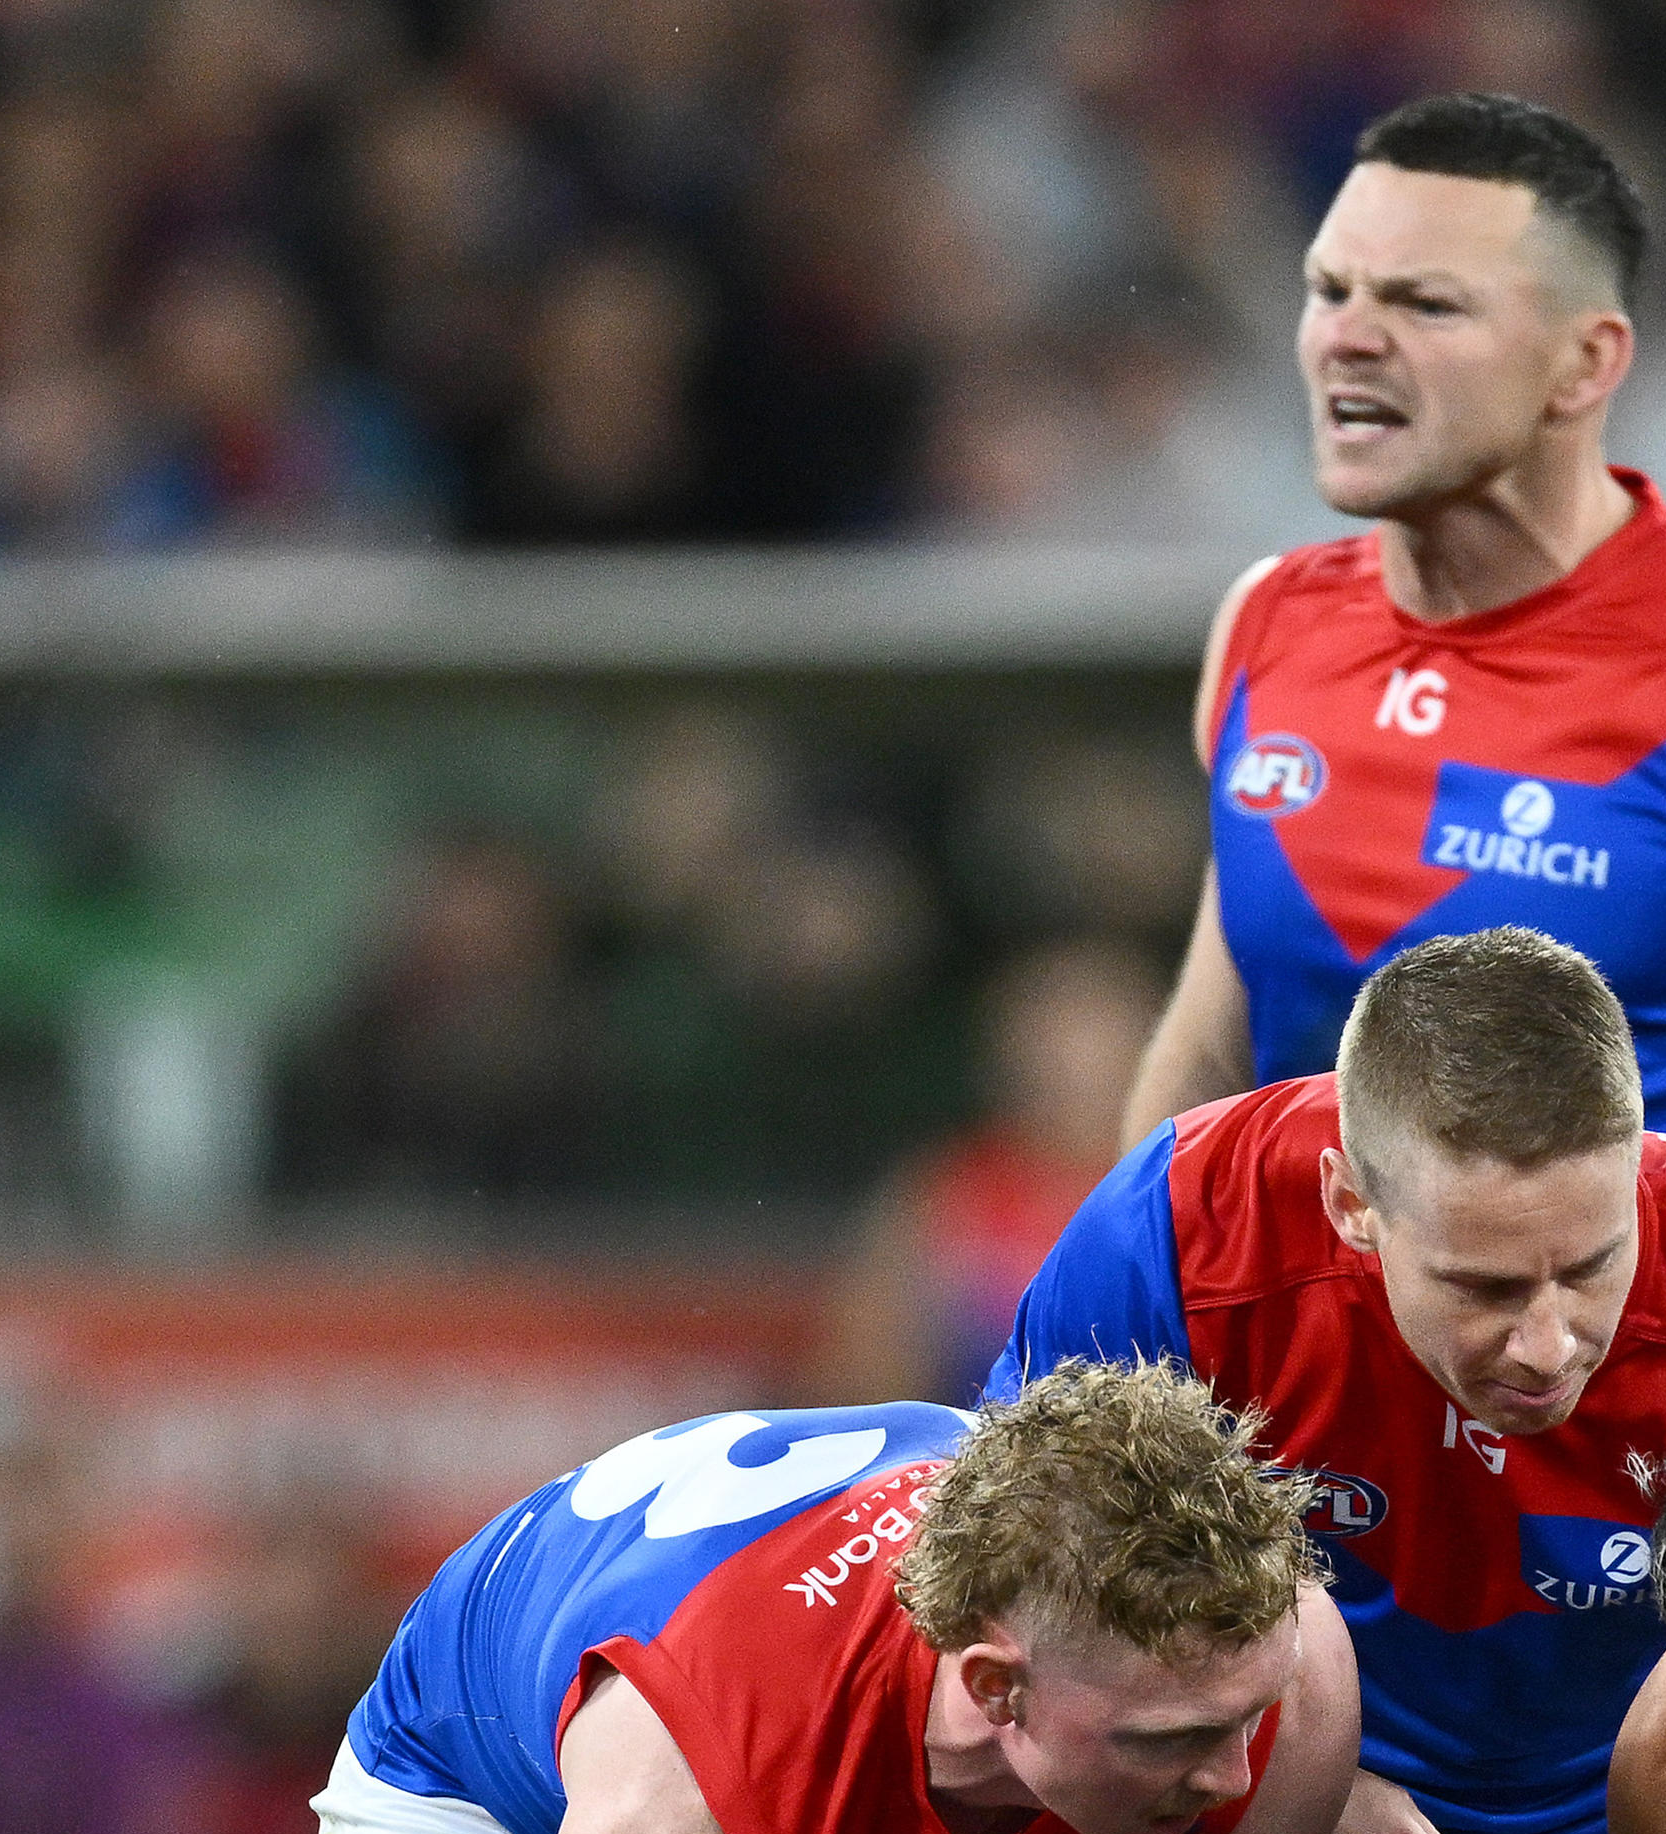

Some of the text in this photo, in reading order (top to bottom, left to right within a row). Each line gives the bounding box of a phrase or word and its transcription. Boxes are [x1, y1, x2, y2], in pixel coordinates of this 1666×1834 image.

[1375, 667, 1448, 735] IG
[1228, 750, 1312, 801] AFL
[1434, 824, 1610, 890] ZURICH
[1443, 1401, 1507, 1475] IG
[782, 1507, 914, 1608] Bank
[1534, 1569, 1646, 1610] ZURI
